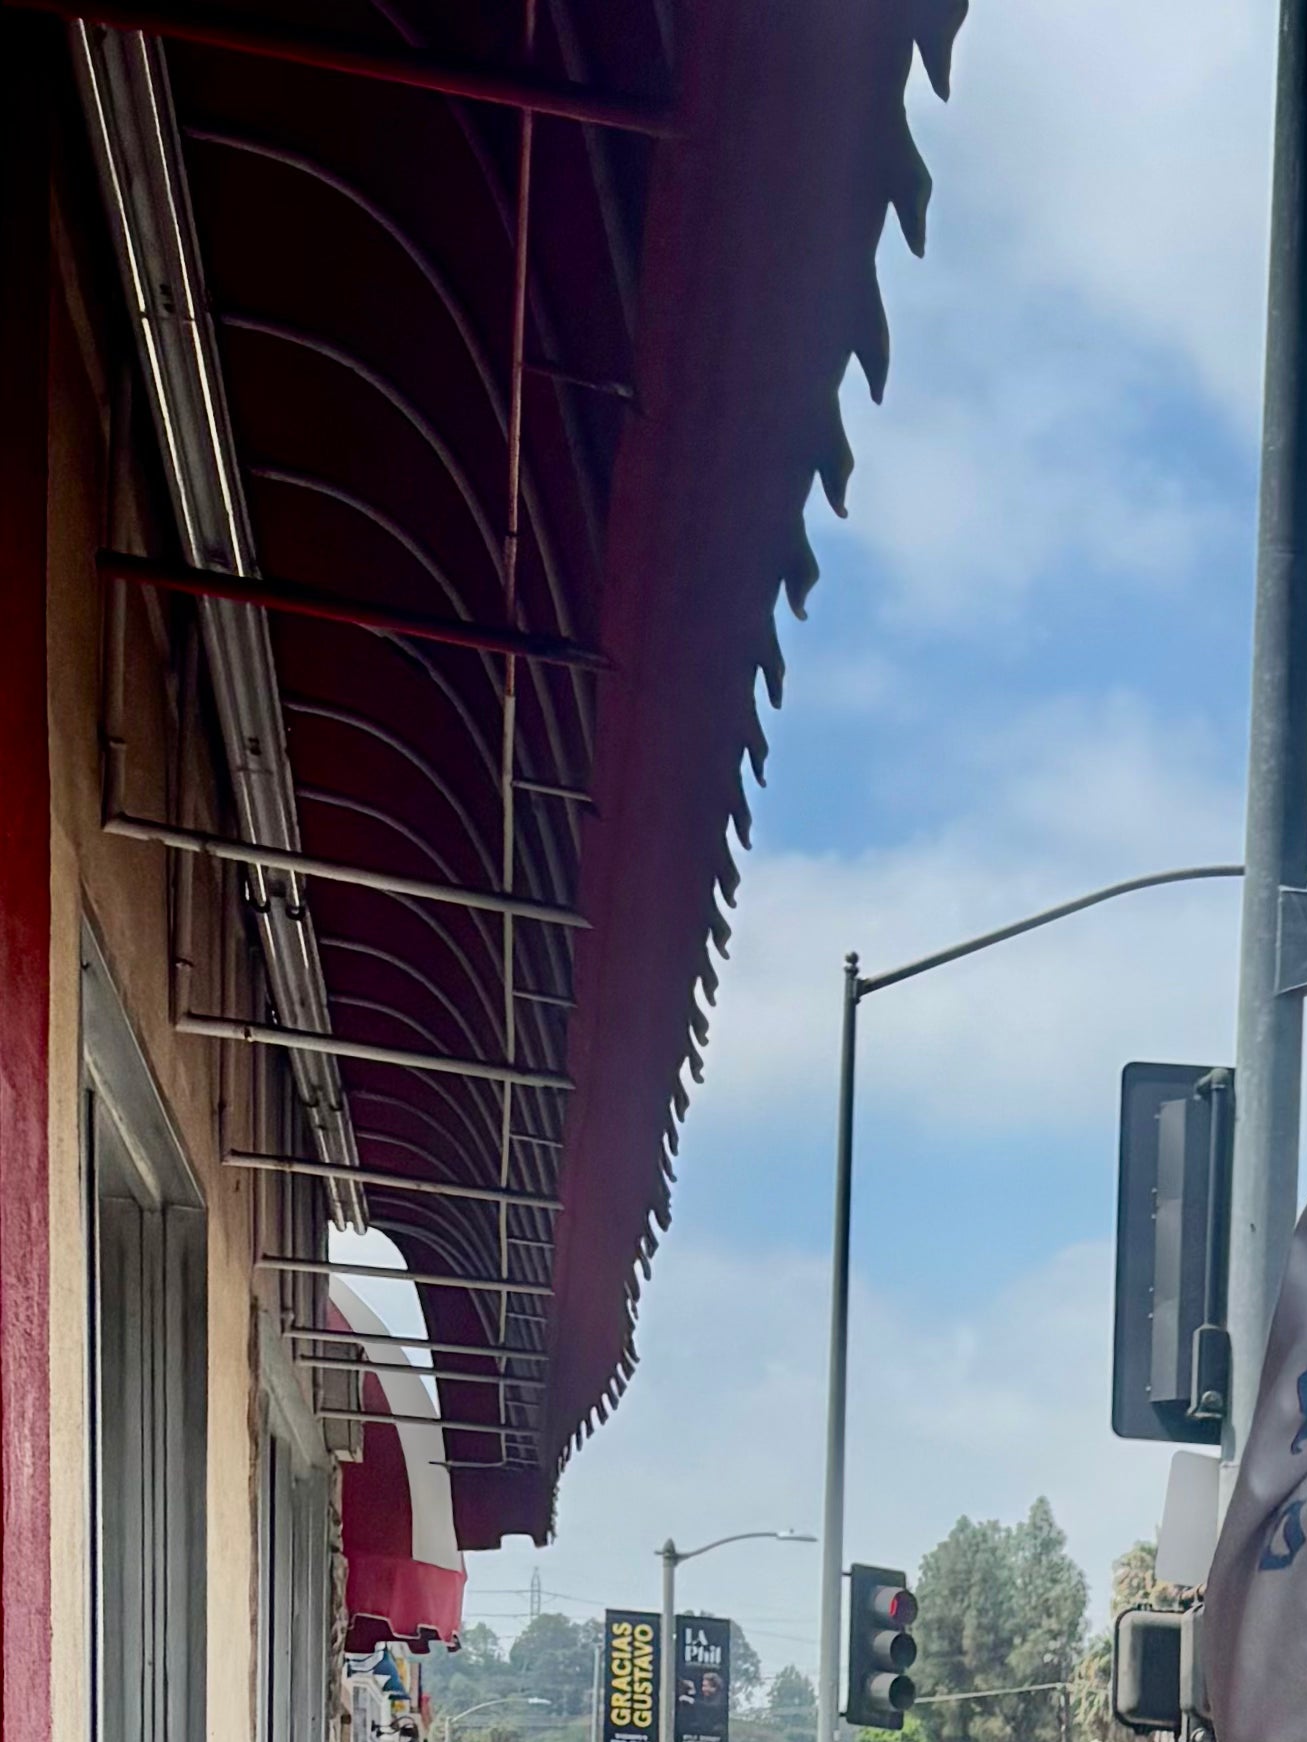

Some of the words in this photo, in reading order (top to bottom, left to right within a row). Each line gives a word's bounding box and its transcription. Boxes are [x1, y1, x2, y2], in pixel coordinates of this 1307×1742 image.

[684, 1645, 721, 1664] Phil
[685, 1628, 708, 1645] LA
[610, 1621, 632, 1727] GRACIAS
[632, 1623, 654, 1728] GUSTAVO
